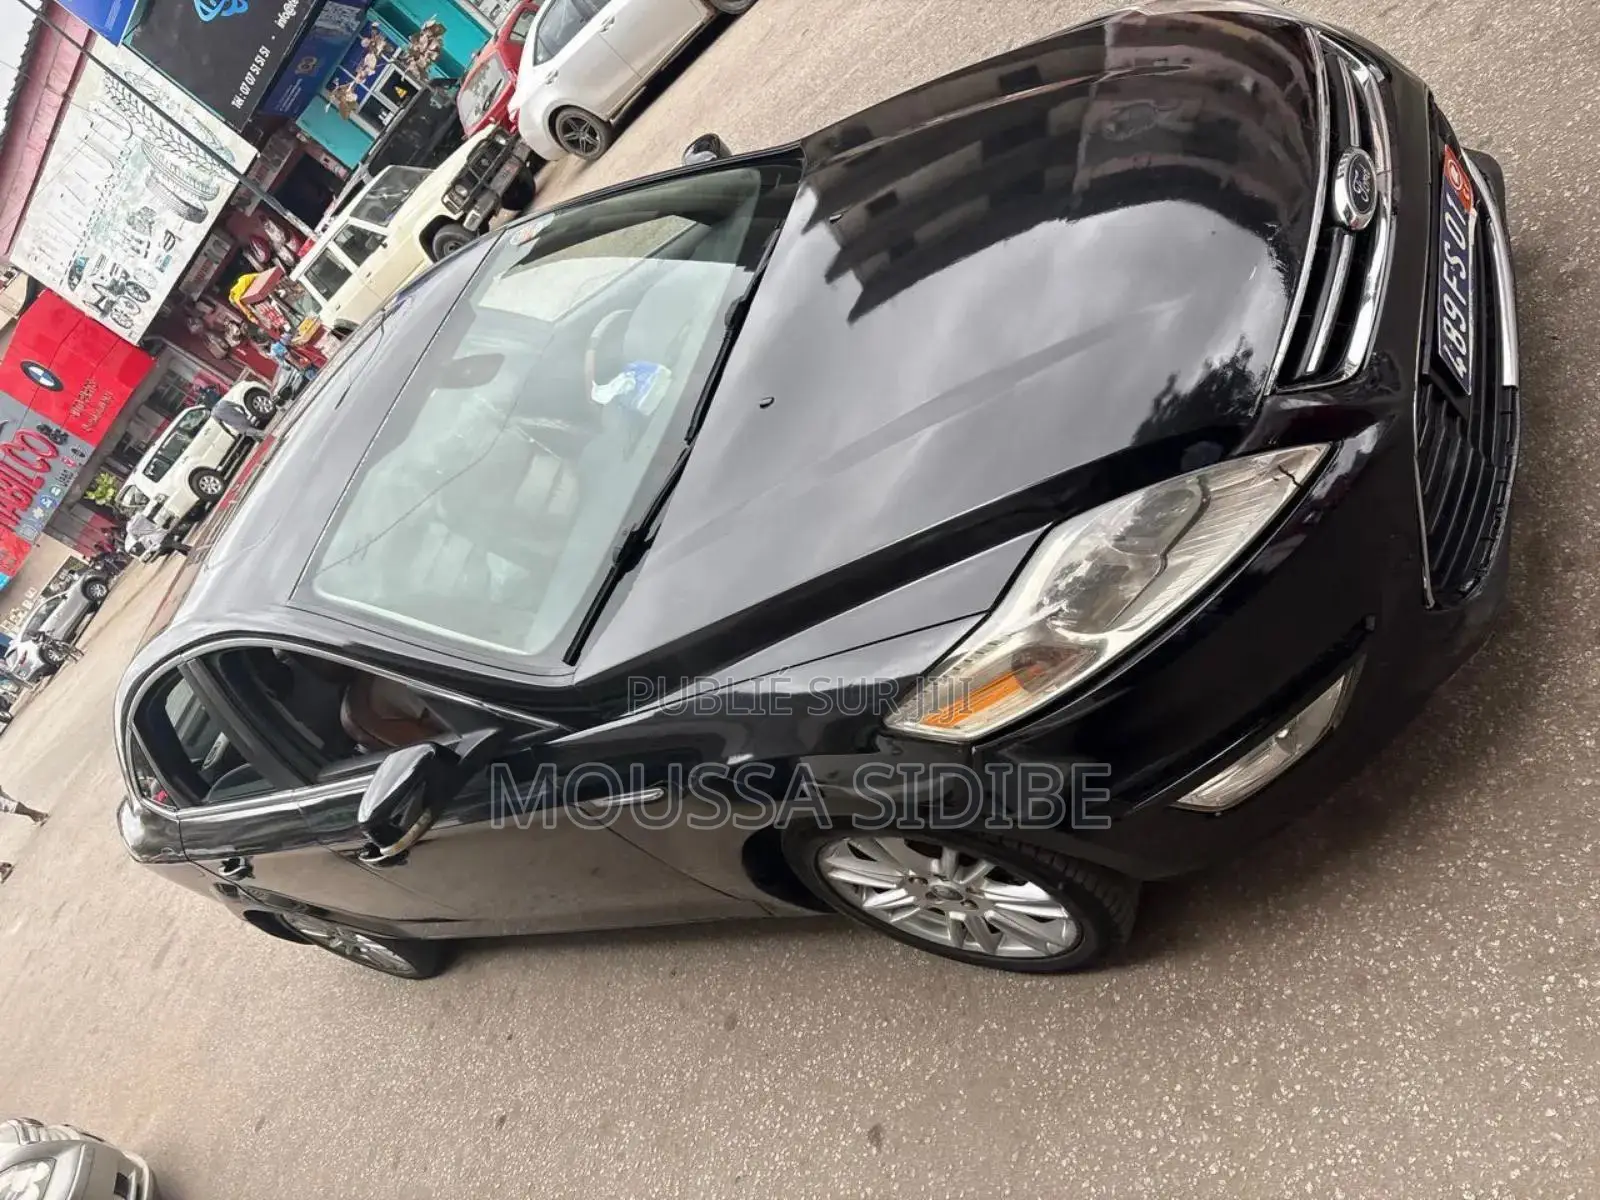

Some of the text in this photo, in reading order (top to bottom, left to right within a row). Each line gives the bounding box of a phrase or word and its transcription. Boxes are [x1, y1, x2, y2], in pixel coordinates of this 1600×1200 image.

[259, 45, 271, 58] 51
[254, 54, 266, 67] 51
[249, 63, 261, 76] 51
[244, 71, 256, 86] 07
[240, 81, 251, 96] 07
